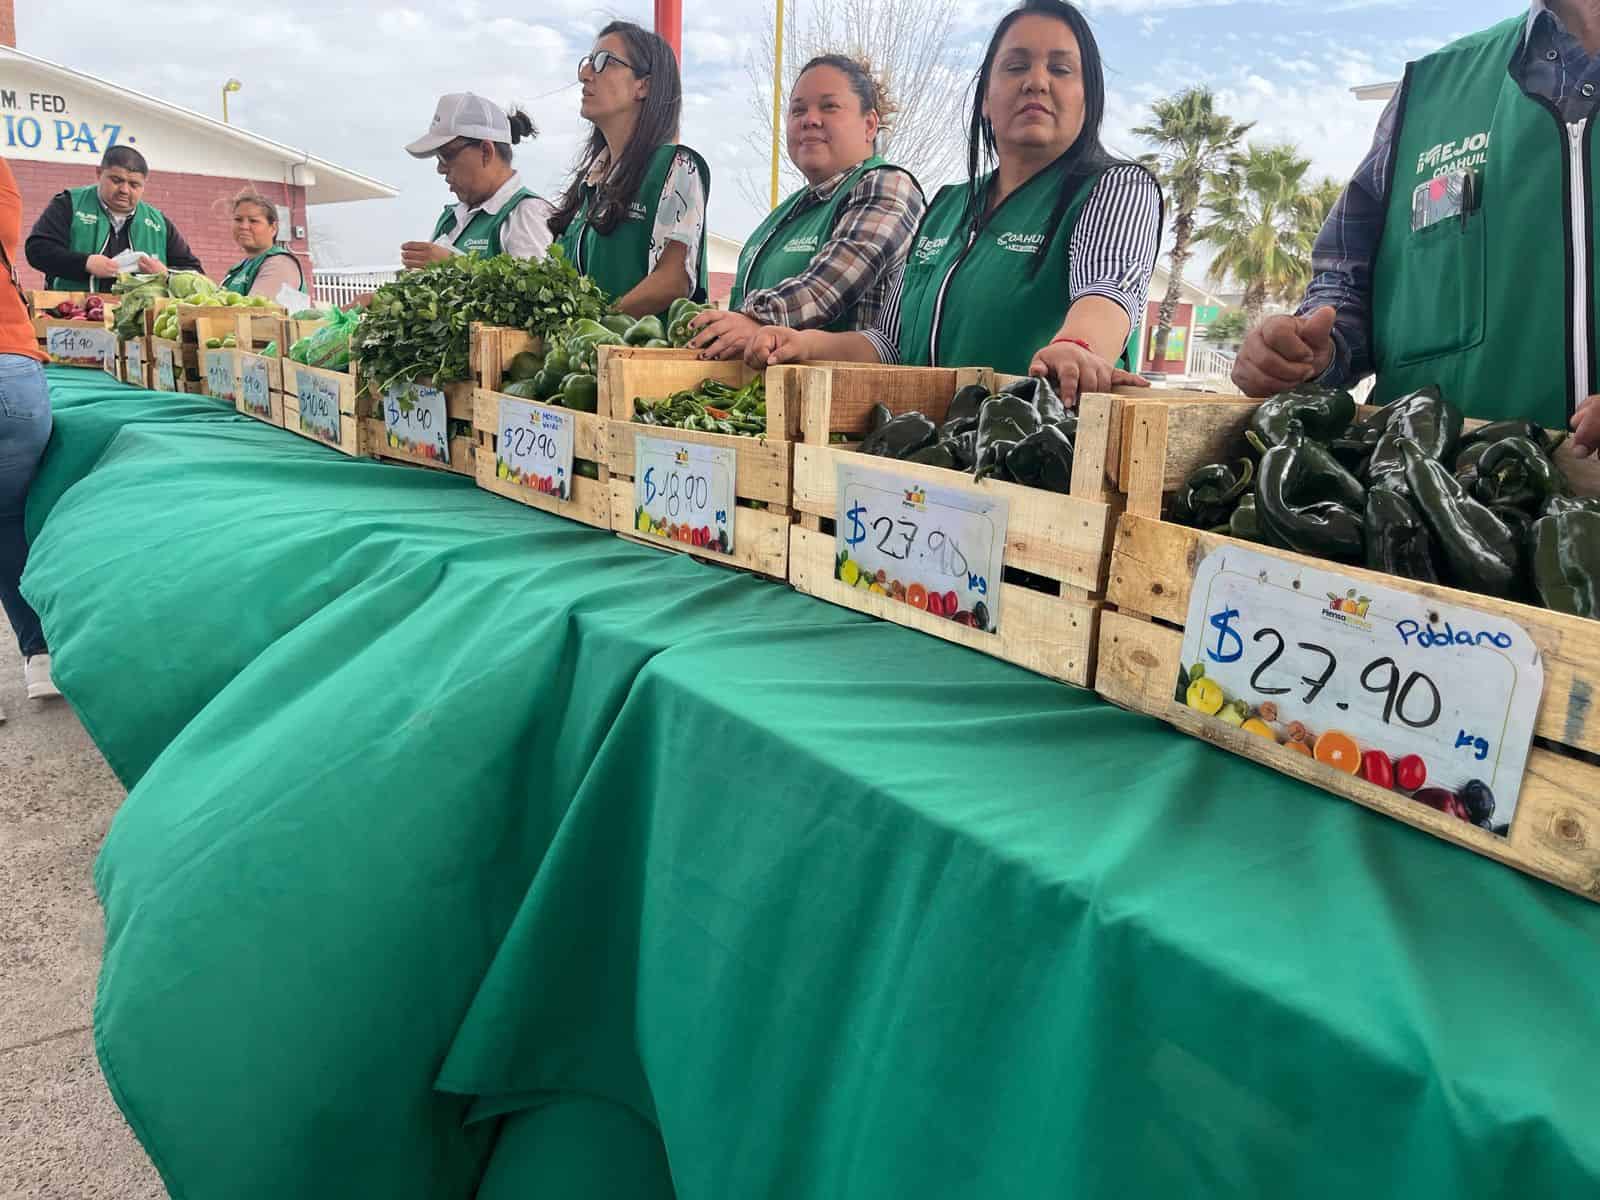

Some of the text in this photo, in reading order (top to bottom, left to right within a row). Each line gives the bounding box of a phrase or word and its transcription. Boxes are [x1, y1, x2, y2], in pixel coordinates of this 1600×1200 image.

[30, 92, 70, 114] FED.
[53, 119, 123, 153] PAZ
[1433, 152, 1488, 179] COAHUIL
[1396, 618, 1513, 649] Poblano
[1455, 729, 1490, 761] kg
